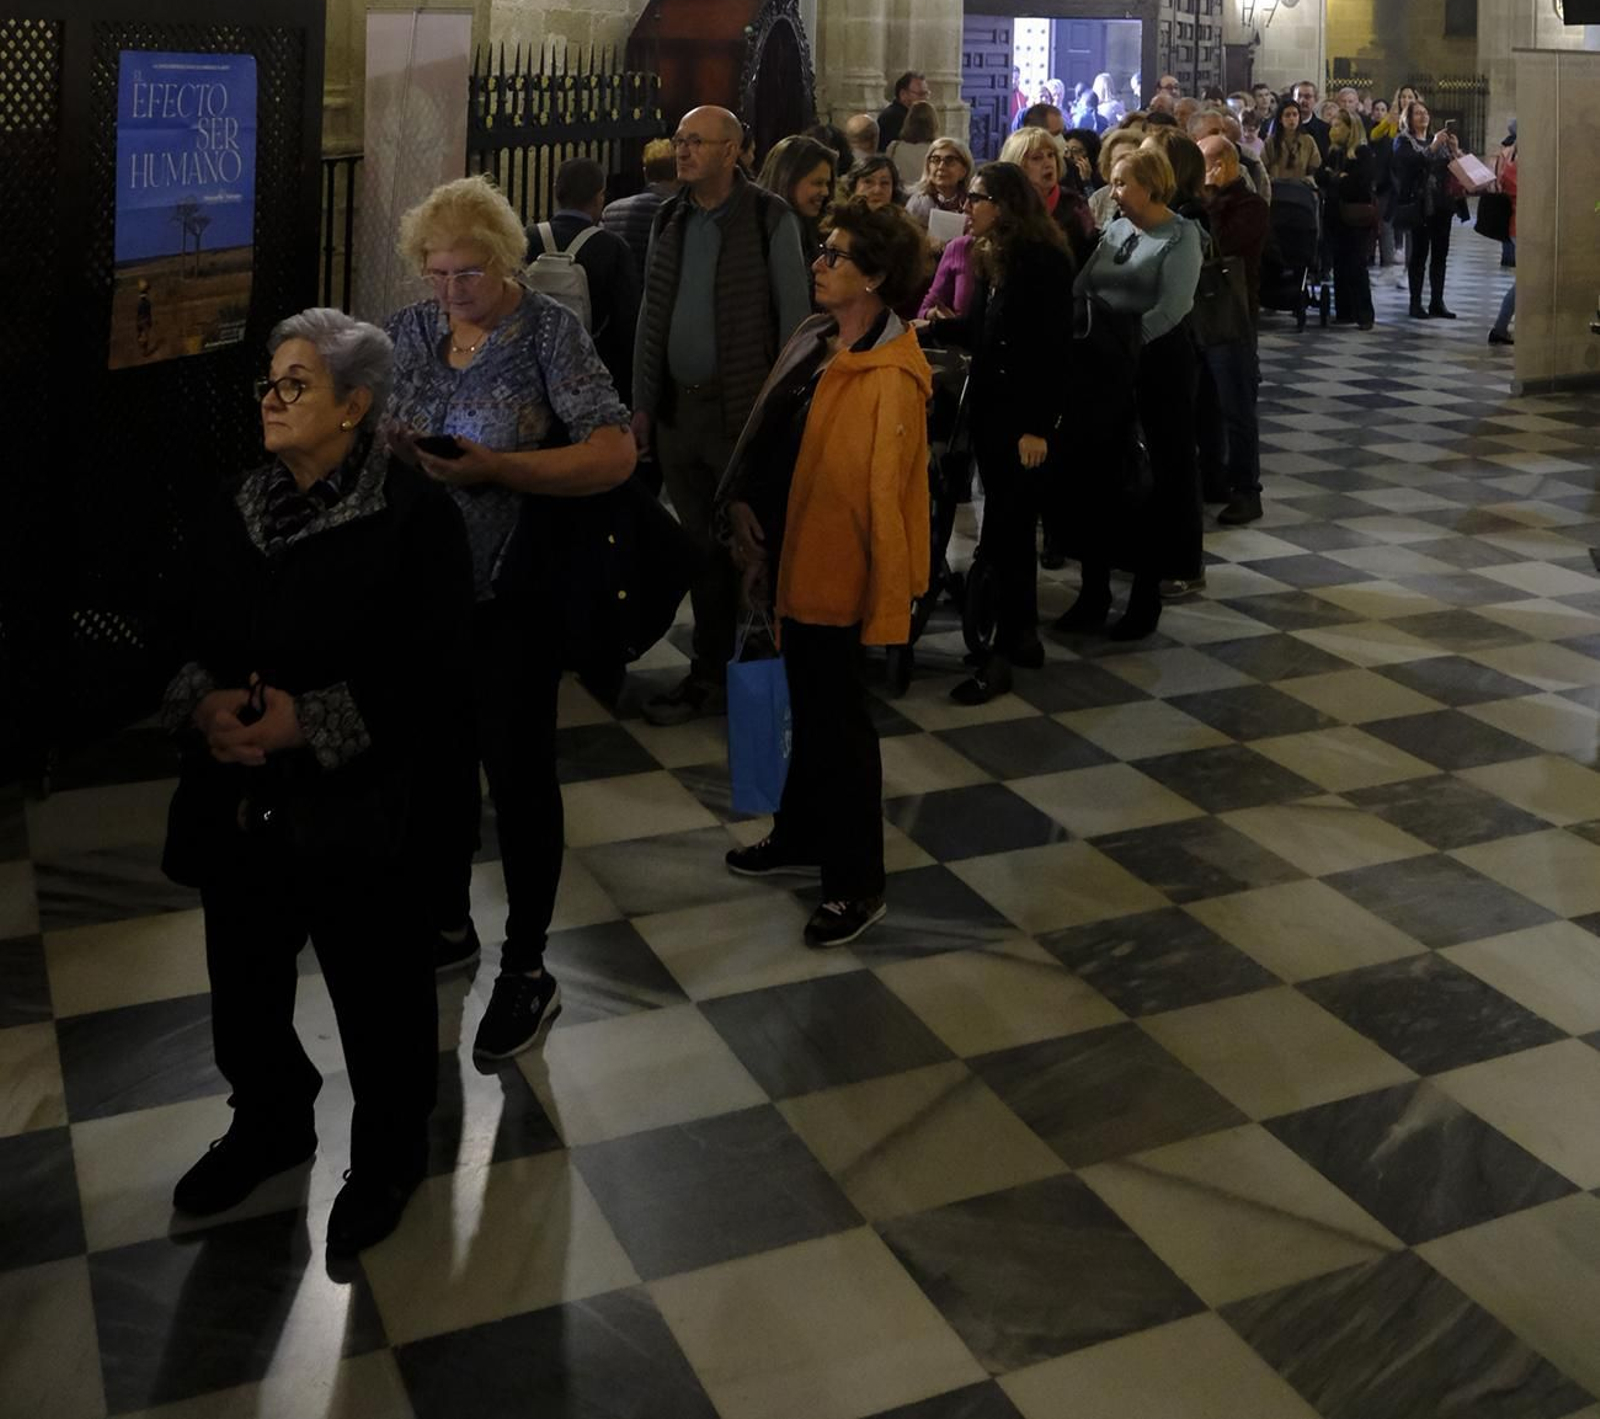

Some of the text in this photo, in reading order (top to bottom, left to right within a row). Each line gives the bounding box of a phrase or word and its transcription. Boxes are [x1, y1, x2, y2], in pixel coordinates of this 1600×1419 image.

[132, 82, 228, 118] EFECTO
[196, 116, 240, 151] SER
[130, 149, 242, 188] HUMANO
